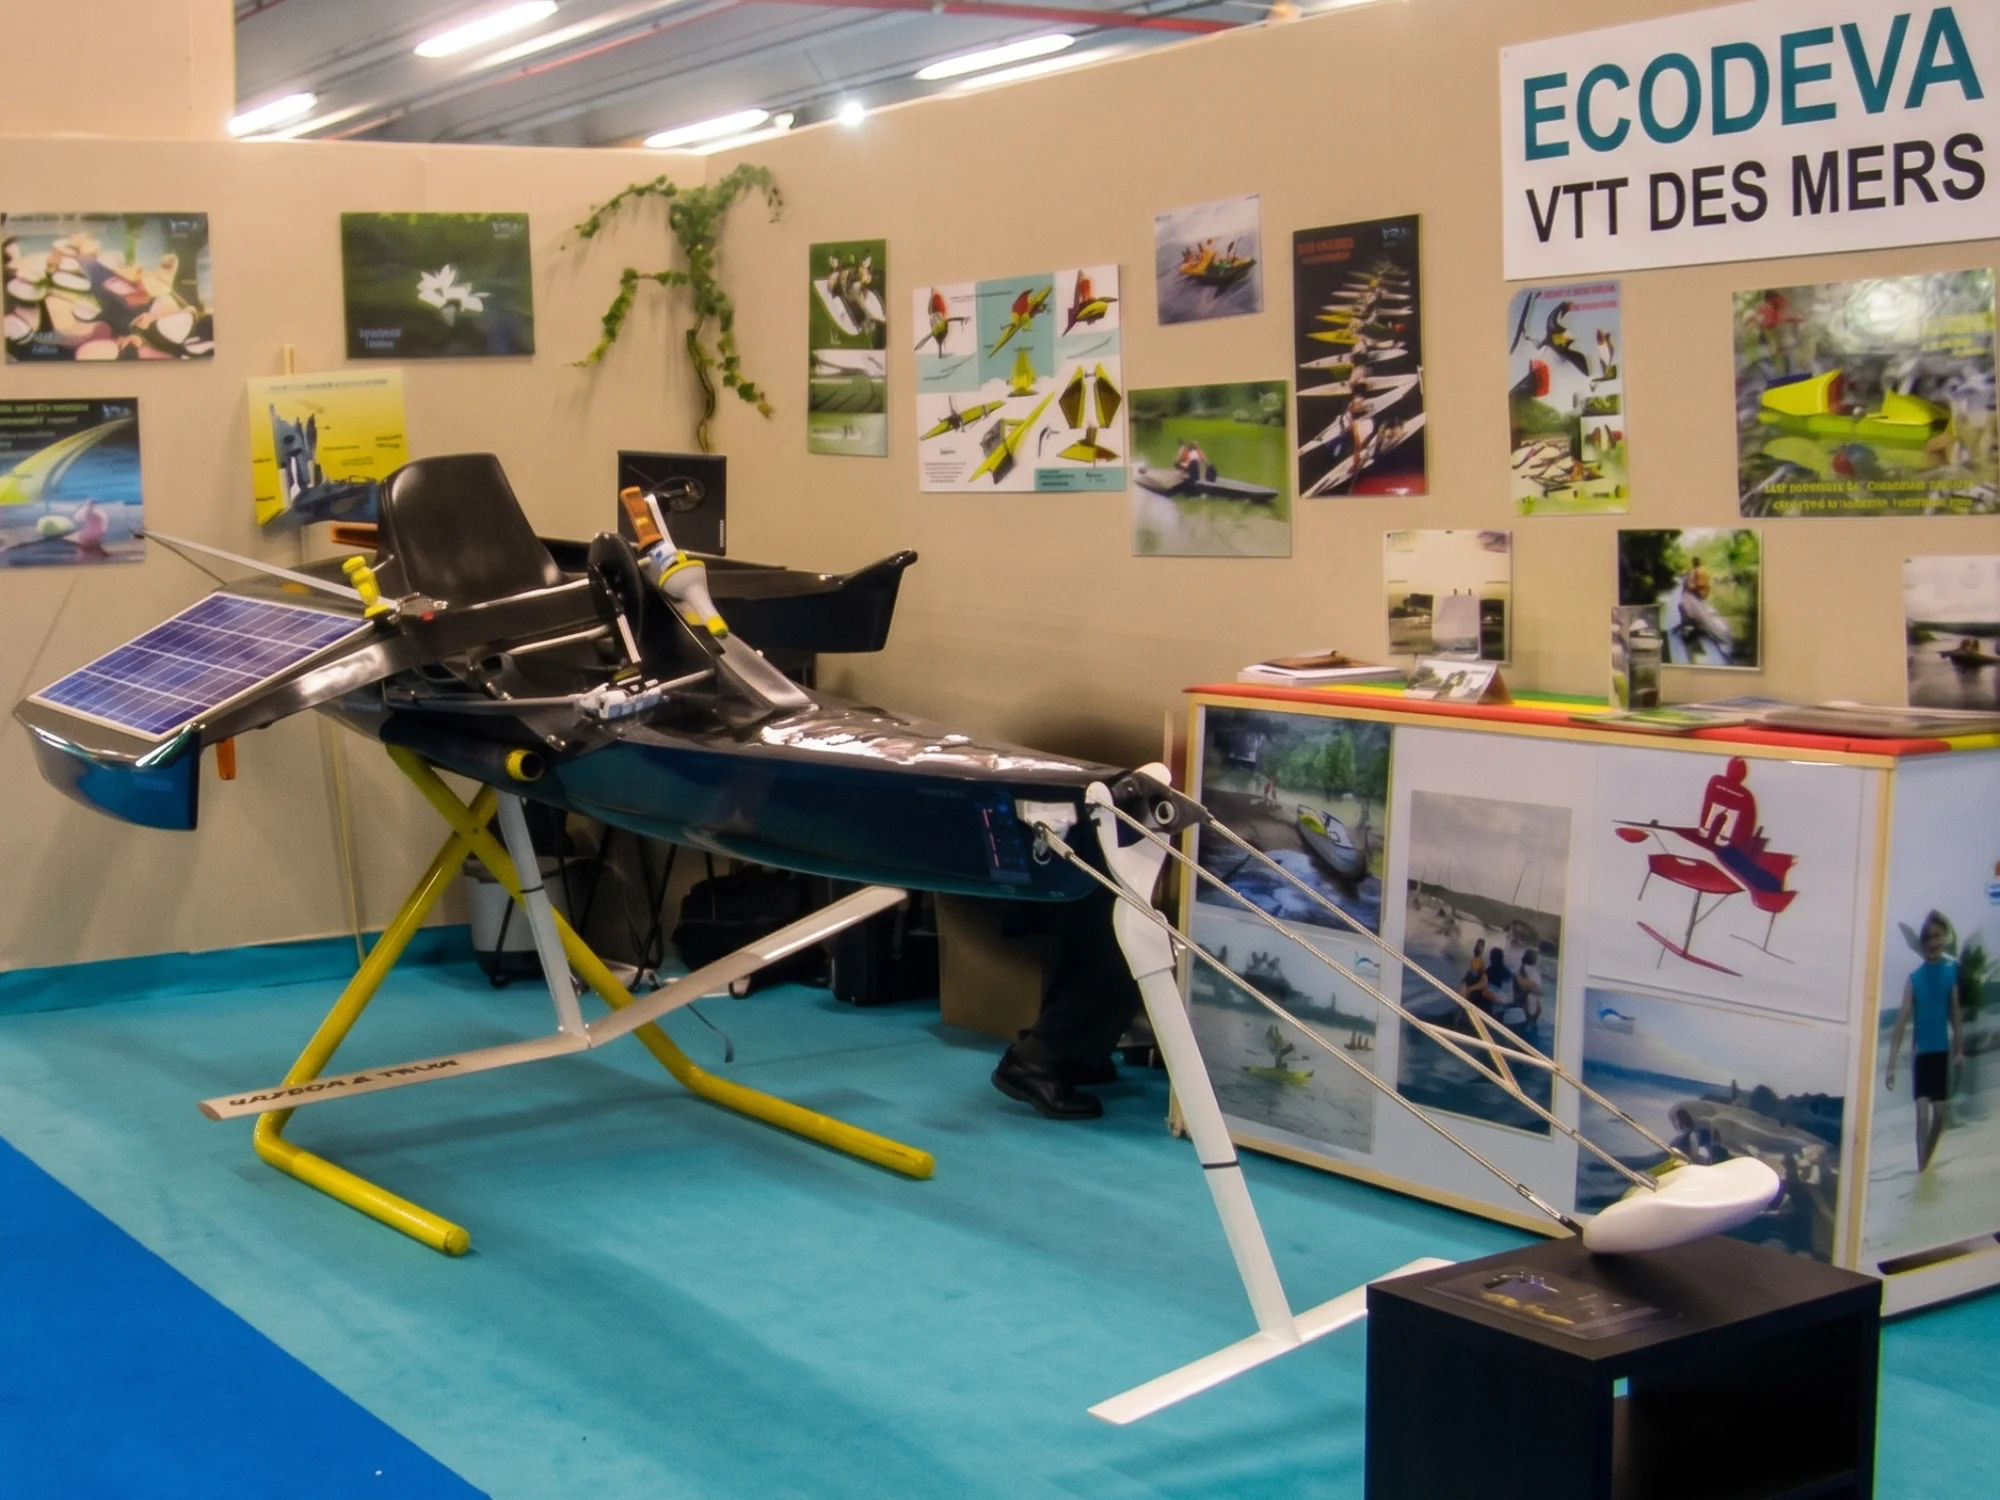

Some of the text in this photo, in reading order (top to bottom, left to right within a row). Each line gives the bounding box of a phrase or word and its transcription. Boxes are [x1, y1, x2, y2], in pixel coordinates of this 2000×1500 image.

[1523, 6, 1985, 161] ECODEVA
[1525, 133, 1986, 243] VTT DES MERS
